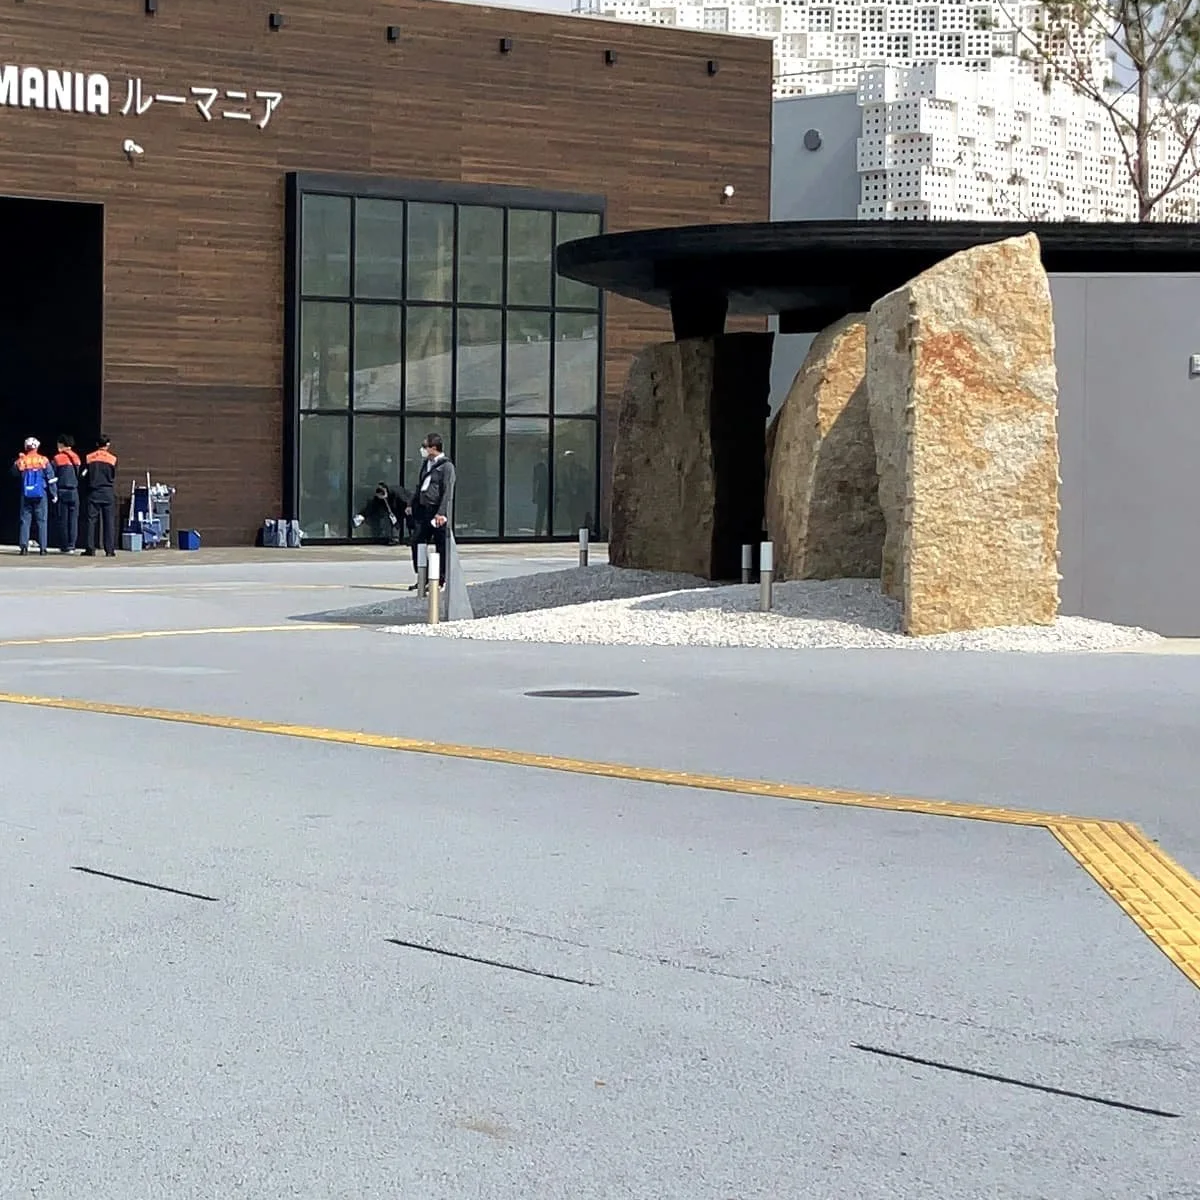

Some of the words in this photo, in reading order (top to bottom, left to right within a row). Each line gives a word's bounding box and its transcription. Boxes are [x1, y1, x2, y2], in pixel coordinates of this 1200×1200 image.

[120, 78, 283, 129] ルーマニア
